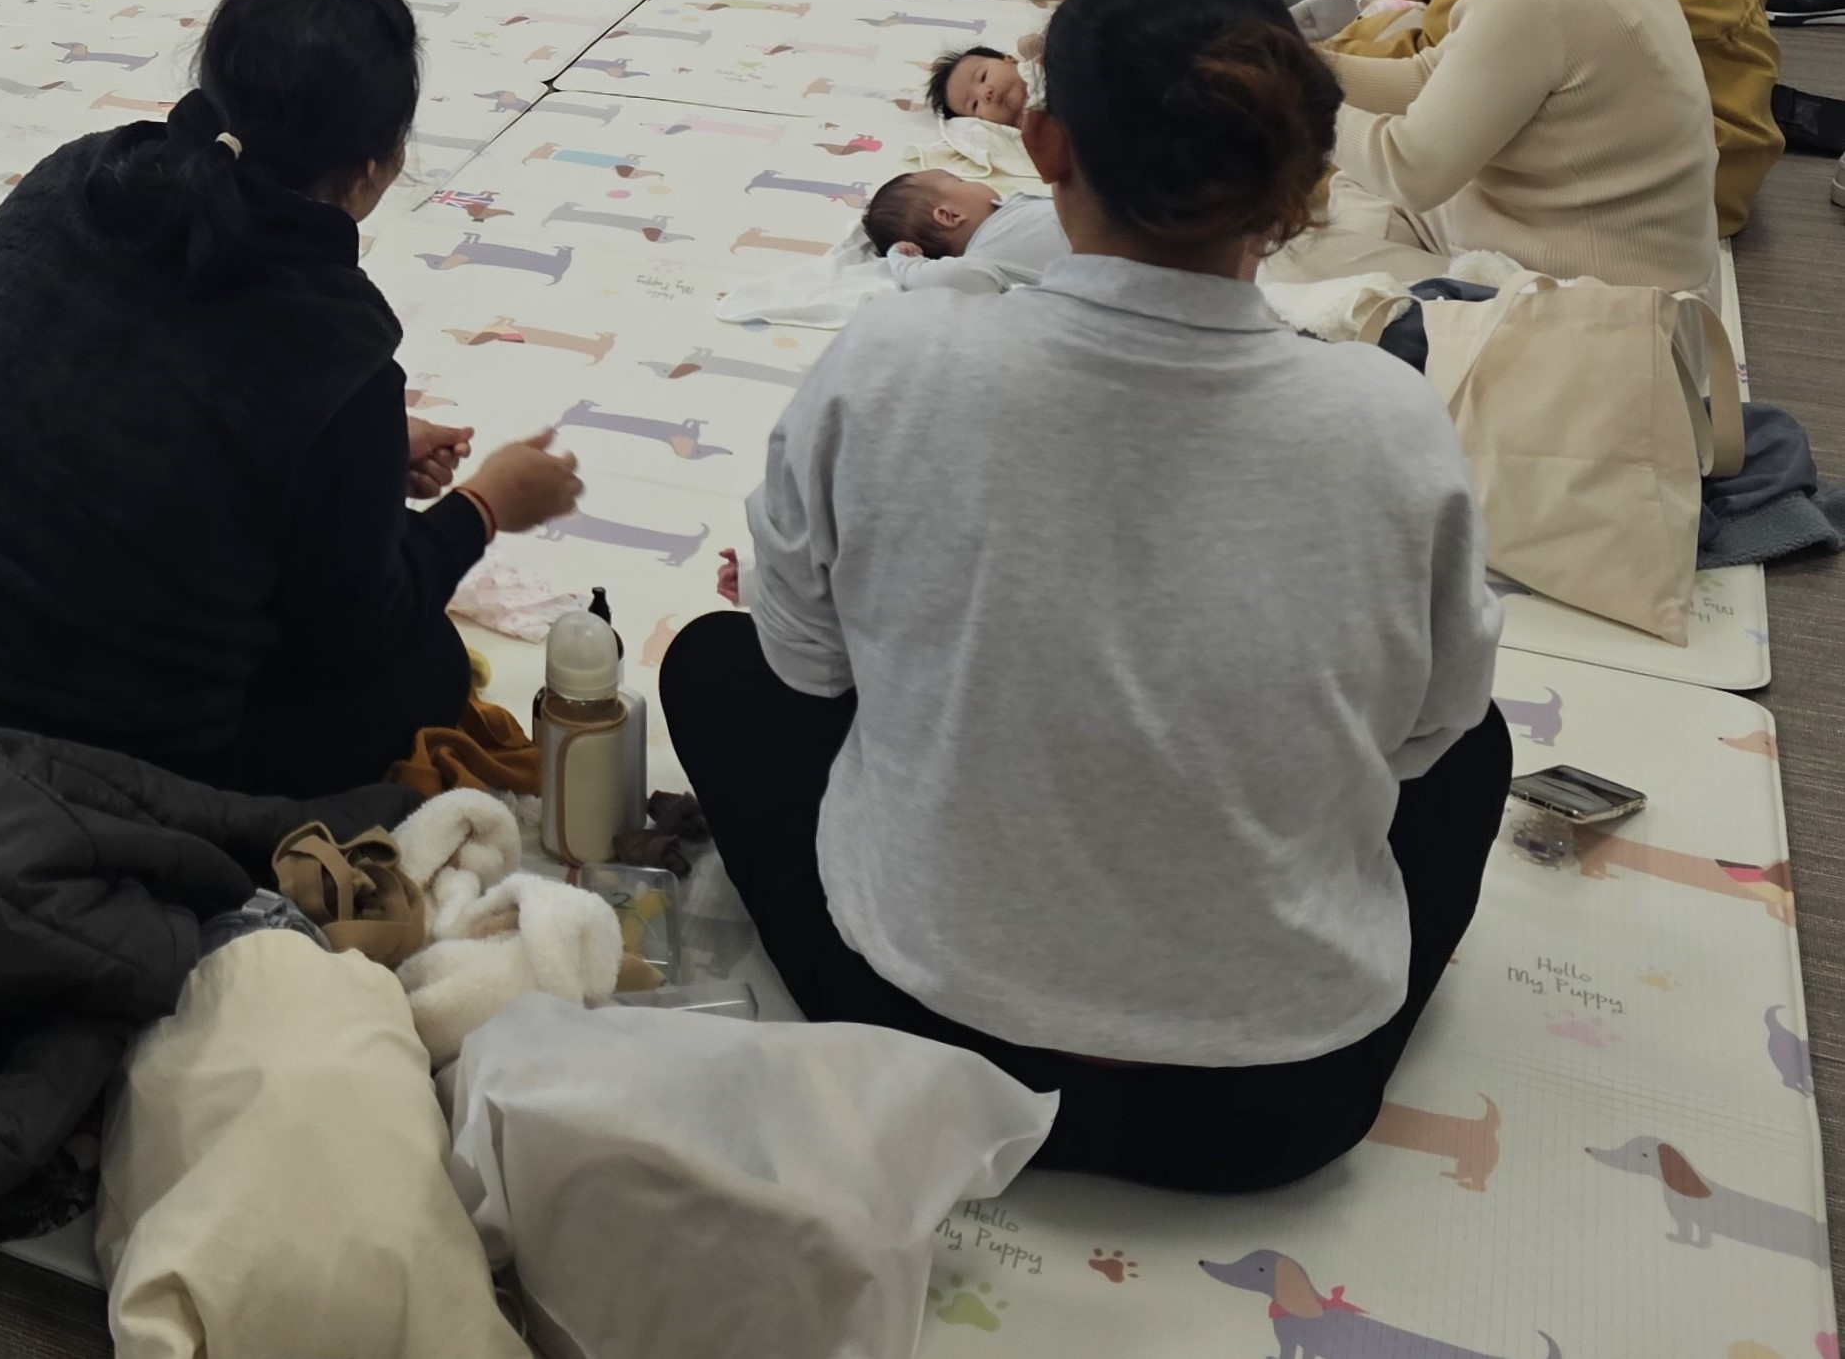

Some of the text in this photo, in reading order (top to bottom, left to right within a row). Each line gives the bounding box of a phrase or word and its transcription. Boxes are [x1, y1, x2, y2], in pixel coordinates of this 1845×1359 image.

[1537, 955, 1592, 983] Hello
[1507, 966, 1626, 1015] My Puppy
[962, 1199, 1020, 1234] Hello
[974, 1226, 1044, 1275] Puppy
